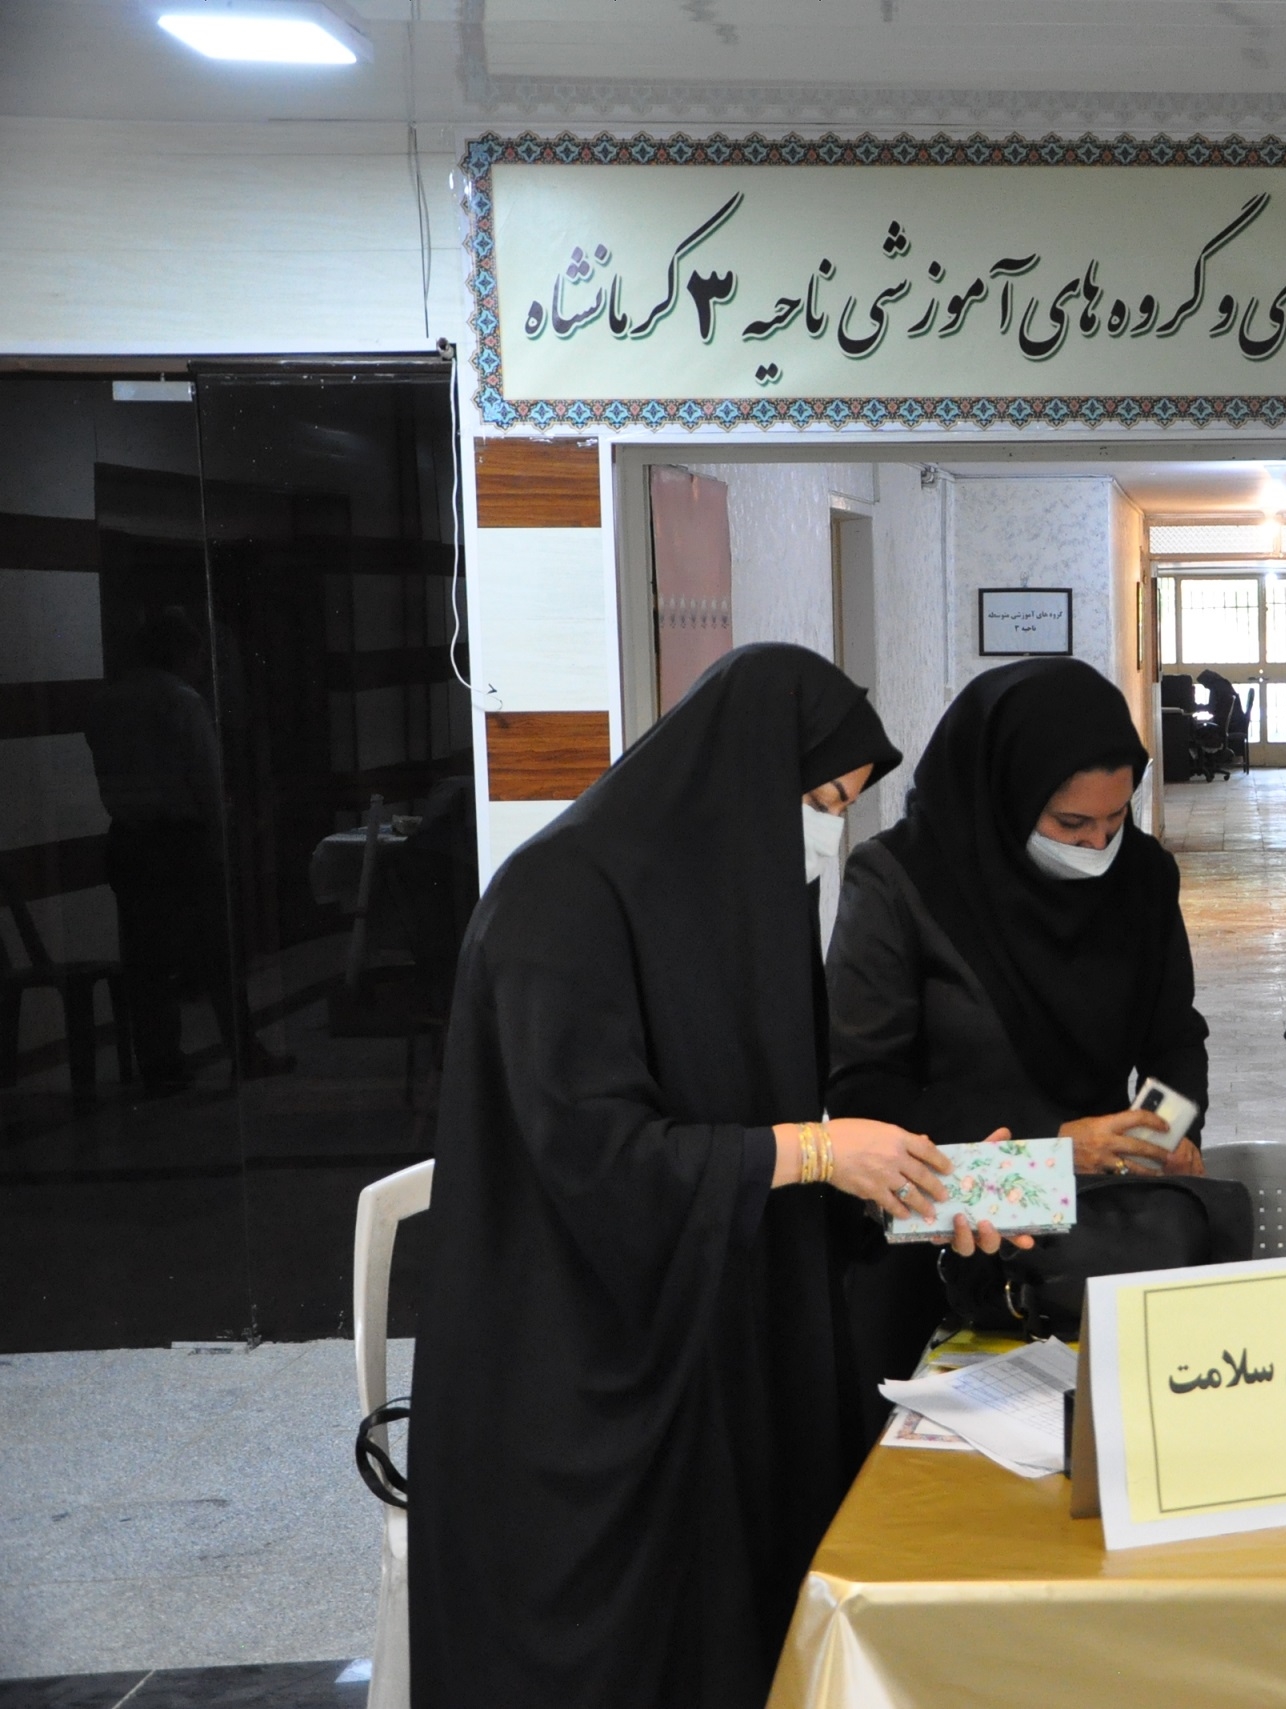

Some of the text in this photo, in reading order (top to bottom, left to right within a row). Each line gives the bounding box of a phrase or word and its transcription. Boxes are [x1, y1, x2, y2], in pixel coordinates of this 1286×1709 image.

[525, 191, 745, 341] کرمانشاه
[686, 270, 734, 340] ۳
[742, 258, 832, 382] ناحیه
[837, 220, 1040, 358] آموزشی
[1168, 1347, 1274, 1394] سلامت
